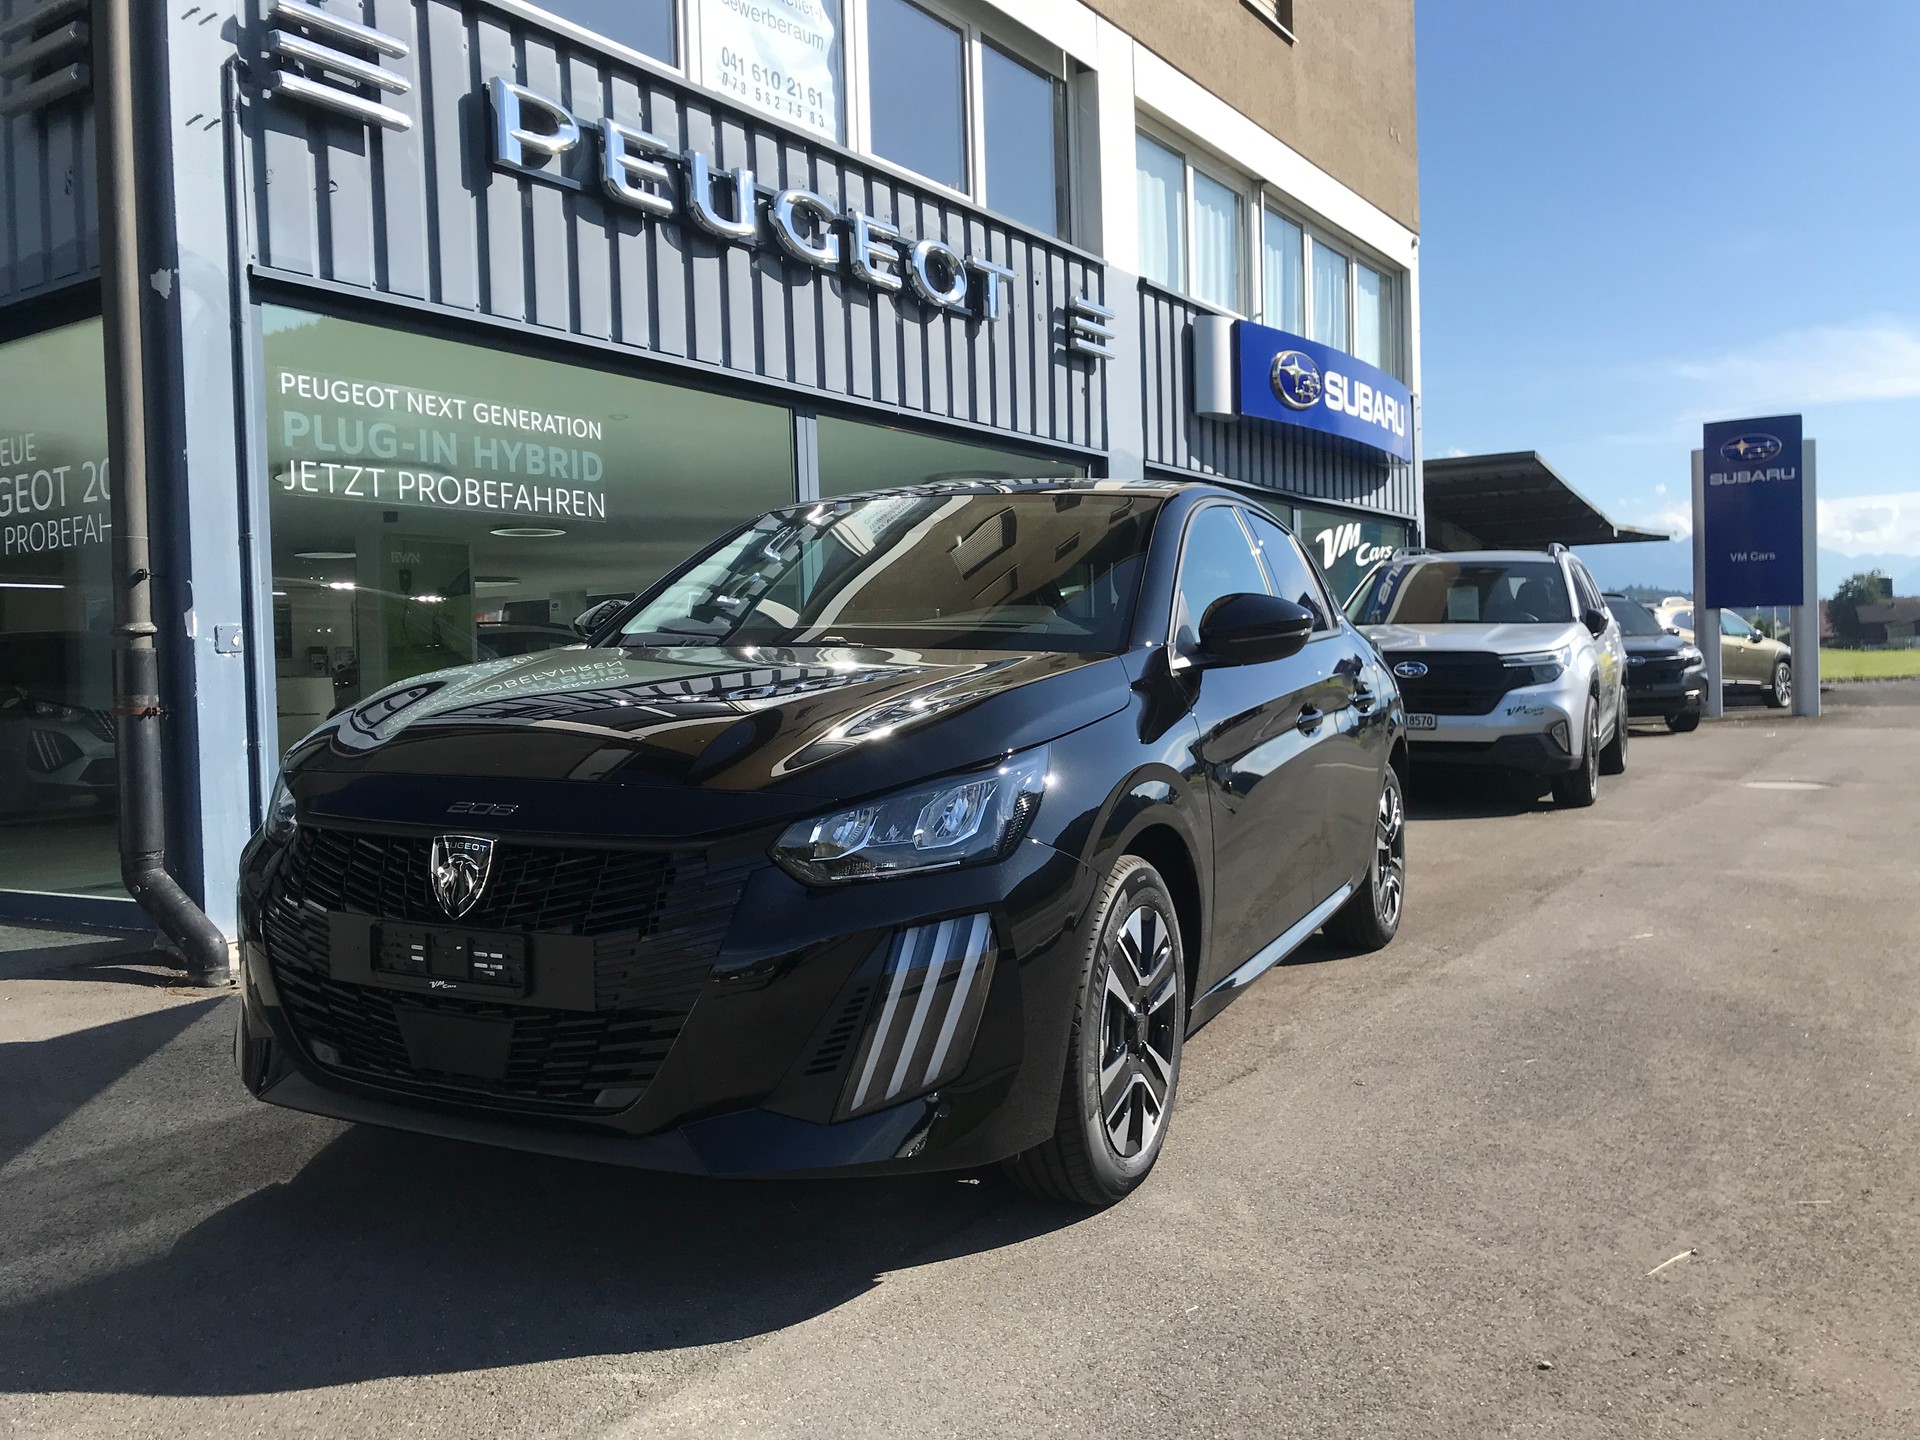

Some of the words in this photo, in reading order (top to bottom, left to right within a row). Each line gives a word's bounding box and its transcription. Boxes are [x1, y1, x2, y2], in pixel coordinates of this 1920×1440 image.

[721, 46, 744, 76] 041
[751, 63, 781, 90] 610
[787, 76, 802, 100] 21
[807, 87, 823, 110] 61
[488, 76, 1014, 322] PEUGEOT
[280, 372, 399, 410] PEUGEOT
[407, 391, 466, 420] NEXT
[473, 402, 602, 441] GENERATION
[1324, 370, 1404, 438] SUBARU
[283, 410, 458, 466] PLUG-IN
[474, 435, 603, 482] HYBRID
[1709, 466, 1796, 486] SUBARU
[284, 459, 385, 498] JETZT
[398, 471, 605, 518] PROBEFAHREN
[1315, 522, 1361, 570] VM
[1355, 542, 1393, 567] Cars
[1729, 551, 1748, 562] VM
[1750, 550, 1776, 562] Cars
